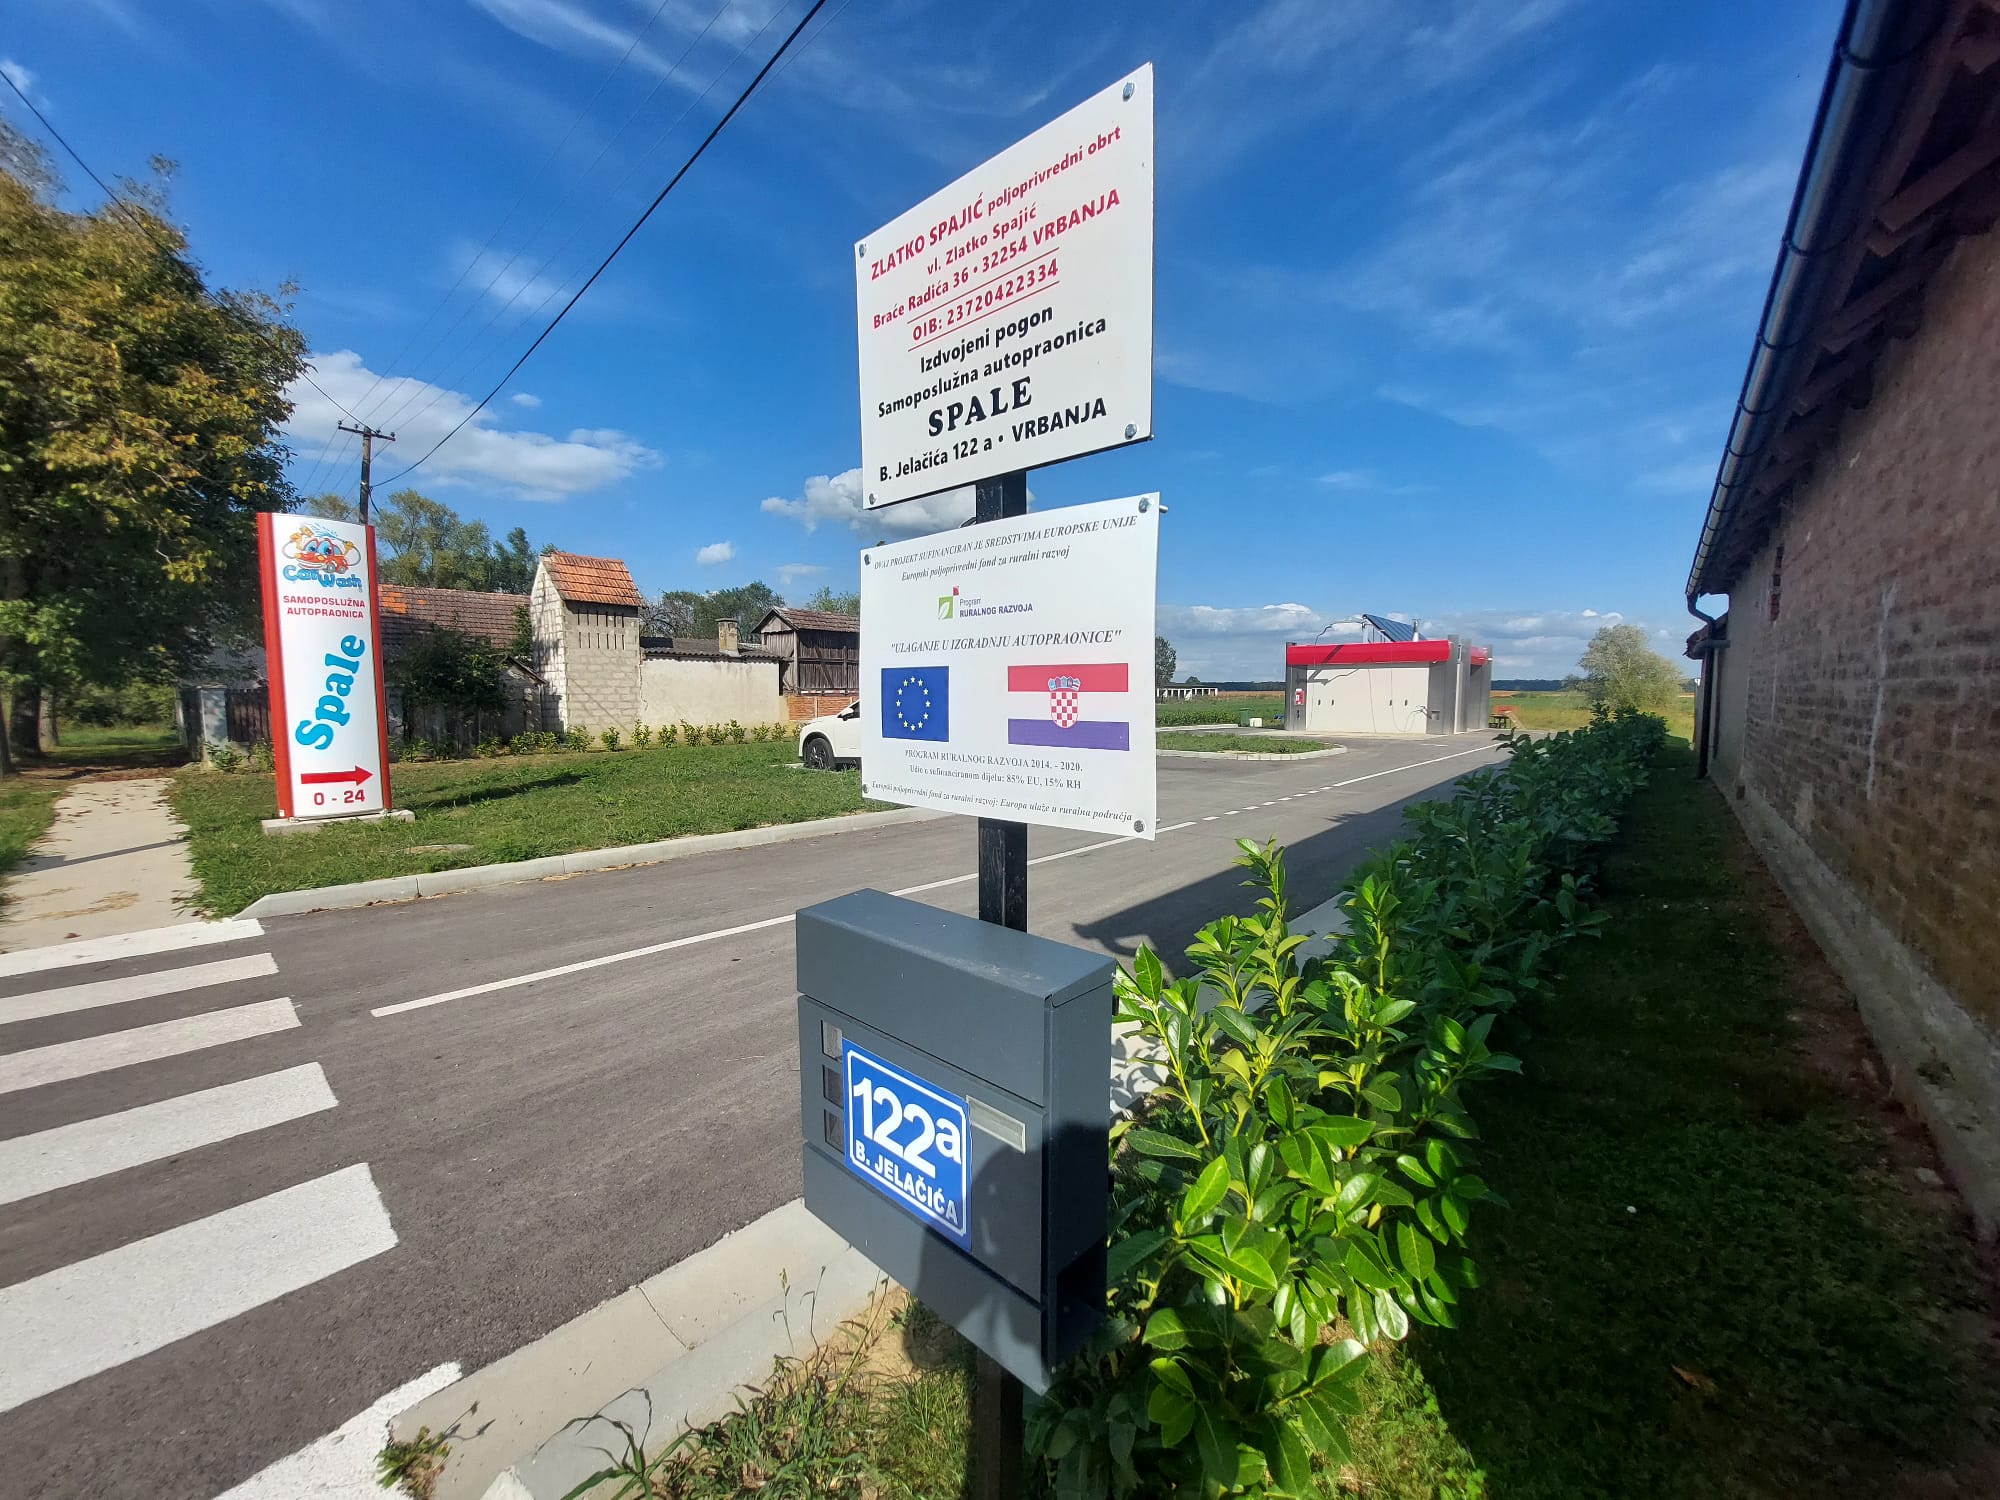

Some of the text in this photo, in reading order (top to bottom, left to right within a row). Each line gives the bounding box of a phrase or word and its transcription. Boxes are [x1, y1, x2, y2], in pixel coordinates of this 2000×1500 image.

[871, 126, 1120, 280] ZLATKO SPAJIĆ poljoprivredni obrt
[873, 189, 1120, 329] Braće Radića 36 32254 VRBANJA
[927, 202, 1037, 275] vl. Zlatko Spajić
[913, 258, 1059, 341] OIB: 23720422334
[878, 318, 1106, 418] Samoposlužna autopraonica
[920, 306, 1053, 373] Izdvojeni pogon
[928, 376, 1032, 436] SPALE
[880, 397, 1107, 481] B. Jelačića 122 a VRBANJA
[890, 553, 918, 567] PROJEKT
[919, 542, 972, 561] SUFINANCIRAN
[973, 541, 984, 551] JE
[985, 530, 1041, 549] SREDSTVIMA
[1044, 521, 1099, 539] EUROPSKE
[1102, 515, 1138, 530] UNIJE
[901, 545, 1071, 581] Europski poljoprivredni fond za ruralni razvoj
[283, 595, 366, 608] SAMOPOSLUŽNA
[287, 607, 364, 618] AUTOPRAONICA
[960, 603, 1033, 618] RURALNOG RAZVOJA
[942, 640, 949, 650] U
[951, 635, 1011, 650] IZGRADNJU
[1013, 629, 1122, 647] AUTOPRAONICE"
[295, 634, 366, 750] Spale
[905, 749, 939, 760] PROGRAM
[941, 752, 985, 764] RURALNOG
[987, 755, 1029, 767] RAZVOJA
[1031, 759, 1052, 769] 2014.
[1060, 761, 1083, 772] 2020.
[1006, 774, 1024, 784] 85%
[1045, 777, 1064, 788] 15%
[1066, 780, 1081, 789] RH
[314, 792, 325, 805] 0
[343, 790, 365, 804] 24
[1000, 798, 1027, 810] Europa
[1059, 806, 1091, 817] ruralna
[1092, 809, 1132, 821] područja
[853, 1077, 962, 1179] 122a
[855, 1139, 958, 1223] B. JELAČIĆA
